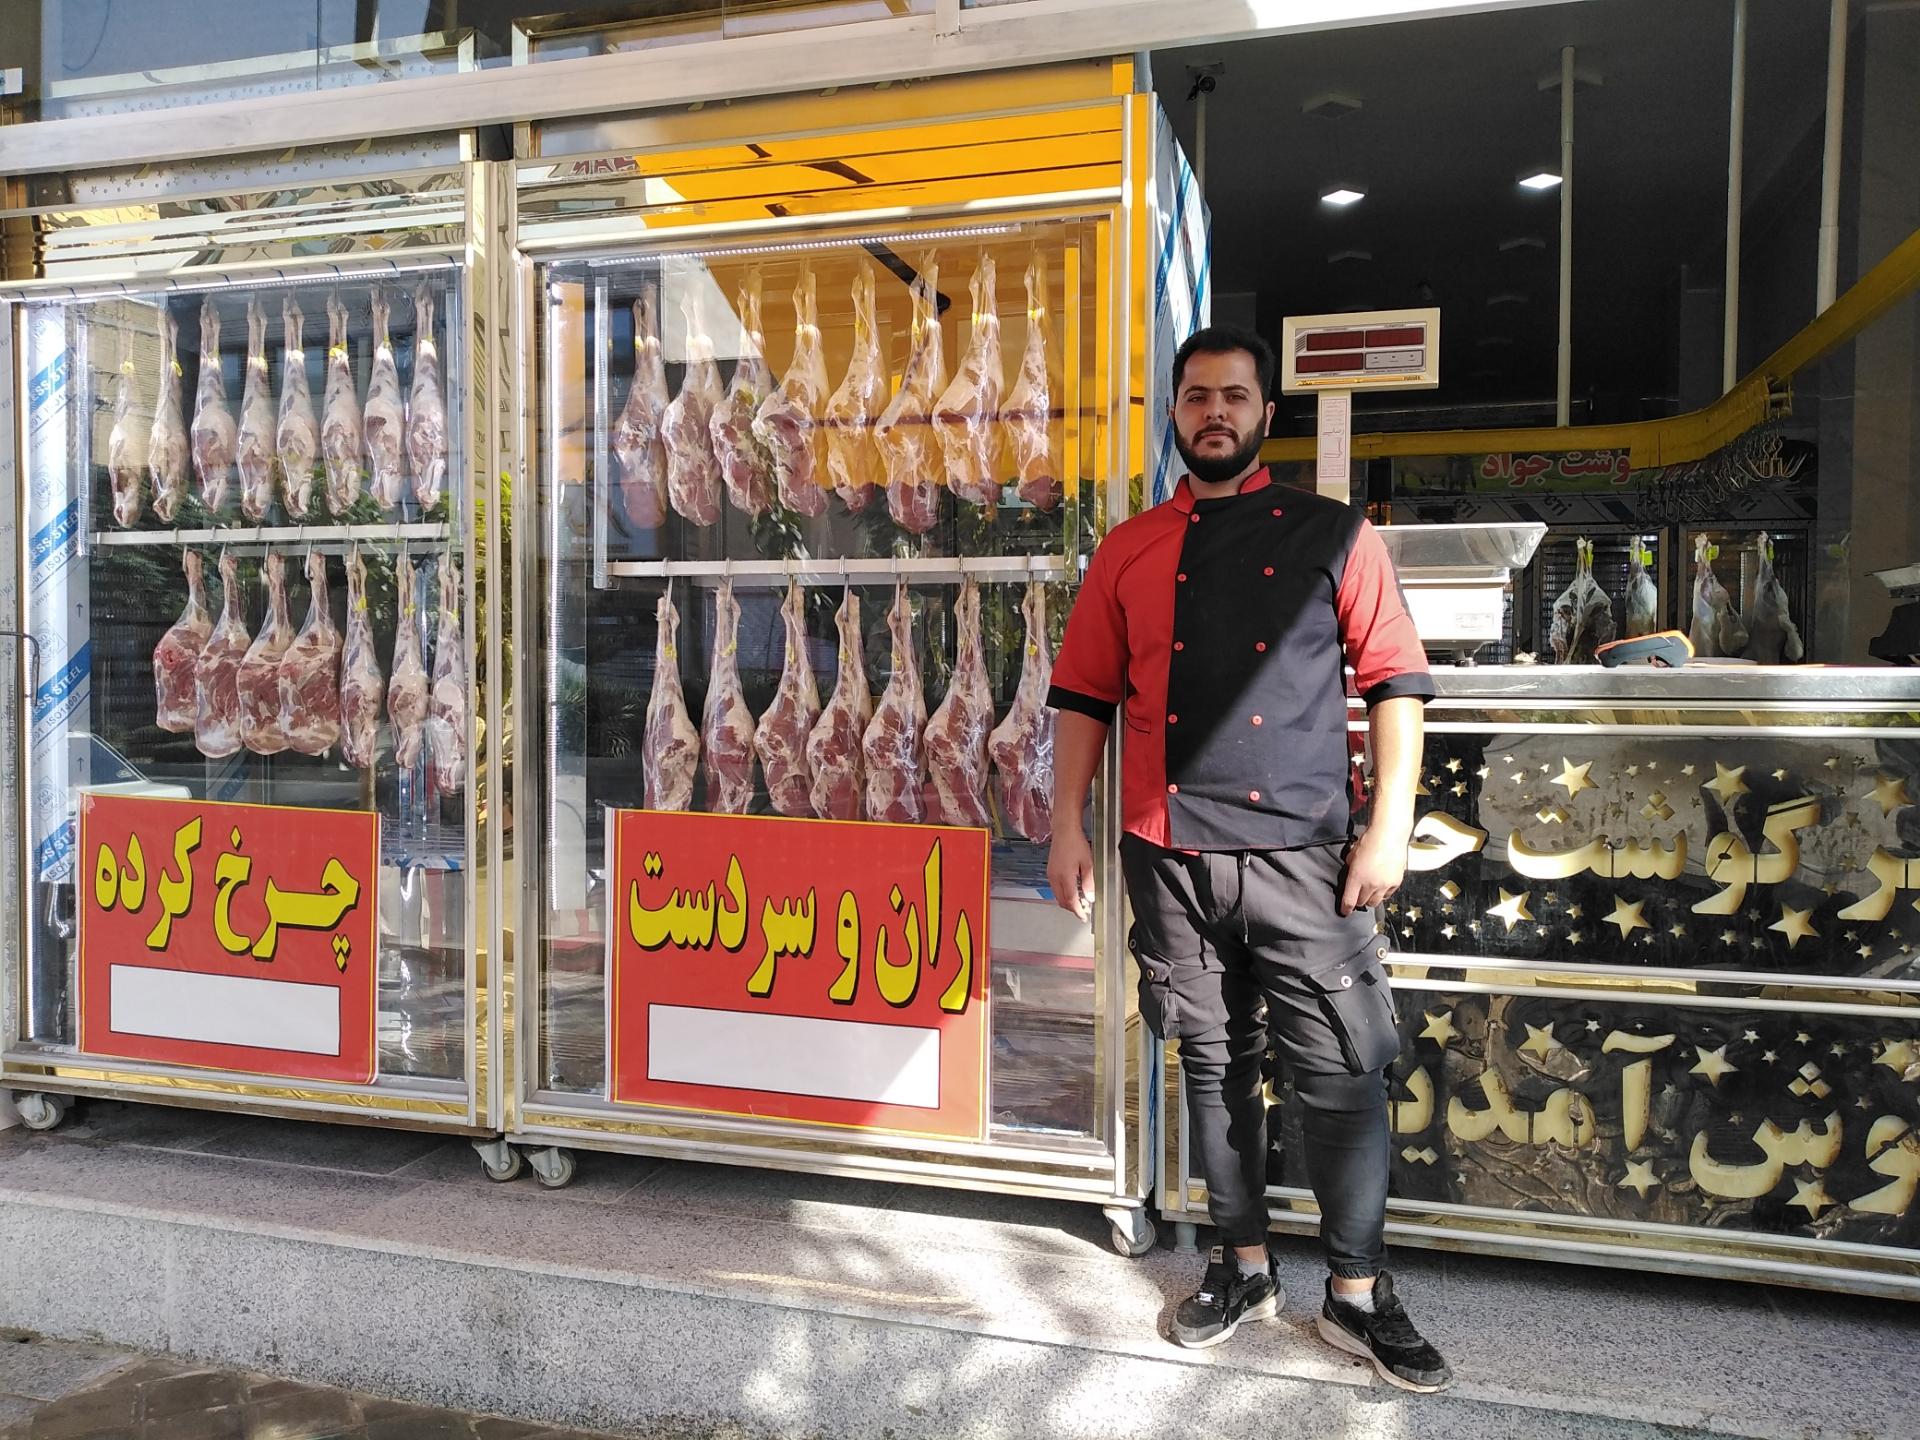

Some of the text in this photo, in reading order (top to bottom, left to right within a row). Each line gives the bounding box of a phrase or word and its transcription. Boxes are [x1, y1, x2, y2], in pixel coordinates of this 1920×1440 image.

[1481, 453, 1553, 487] جواد
[1559, 450, 1641, 486] وشت
[94, 816, 360, 972] چرخ کرده
[1508, 791, 1821, 915] گوشت
[828, 890, 863, 1004] و
[874, 837, 973, 1014] ران
[1689, 1060, 1920, 1215] وش
